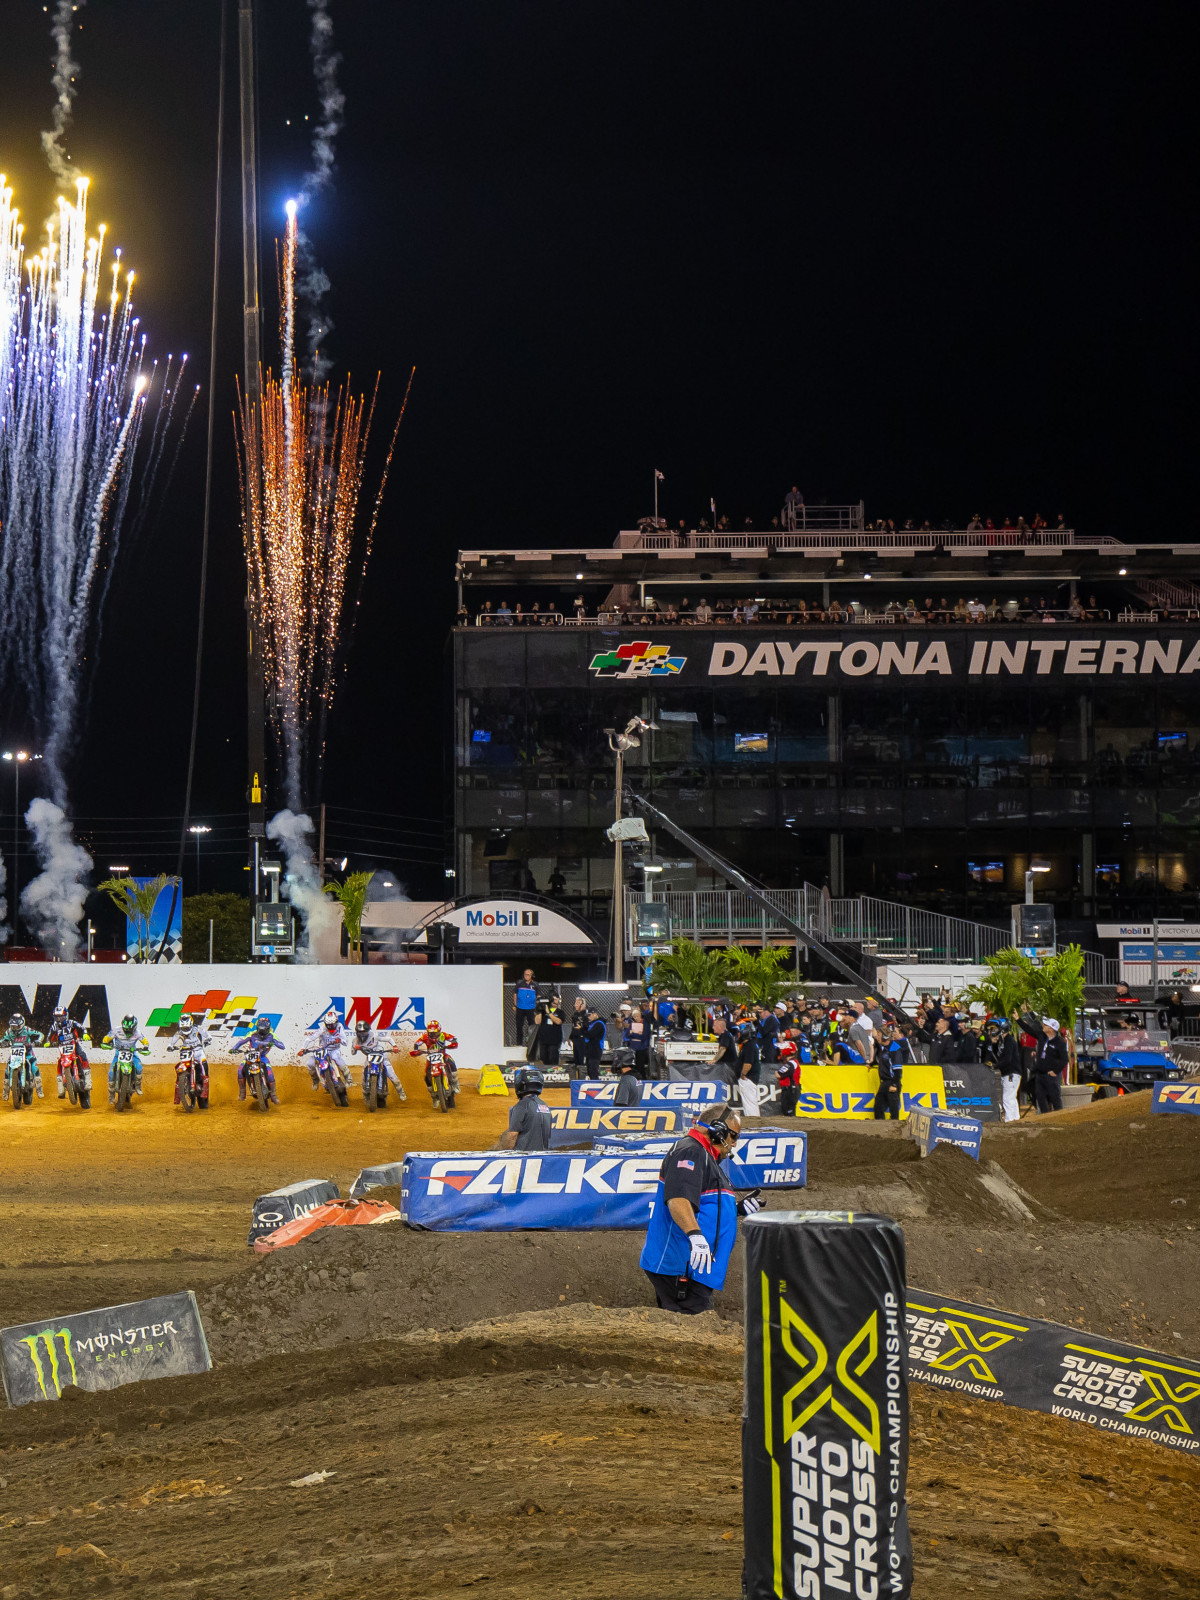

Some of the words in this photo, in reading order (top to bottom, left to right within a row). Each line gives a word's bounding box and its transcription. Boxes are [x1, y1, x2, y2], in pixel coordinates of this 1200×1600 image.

[708, 641, 952, 676] DAYTONA
[466, 911, 518, 926] Mobil
[306, 997, 427, 1030] AMA
[119, 1052, 132, 1061] 33
[577, 1083, 717, 1100] FAKEN
[800, 1093, 939, 1113] SUZKI
[551, 1110, 676, 1131] ALKEN
[937, 1121, 979, 1132] FALKEN
[426, 1159, 662, 1196] FALKE
[763, 1169, 800, 1184] TIRES
[76, 1321, 178, 1353] MONSTER
[96, 1341, 165, 1362] ENERGY
[1060, 1354, 1144, 1386] SUPER
[1062, 1370, 1138, 1399] MOTO
[884, 1292, 901, 1494] CHAMPIONSHIP
[1053, 1384, 1136, 1413] CROSS
[1051, 1404, 1097, 1425] WORLD
[1099, 1417, 1200, 1450] CHAMPIONSHIP
[791, 1431, 820, 1600] SUPER
[821, 1441, 850, 1593] MOTO
[851, 1438, 879, 1600] CROSS
[889, 1501, 903, 1593] WORLD
